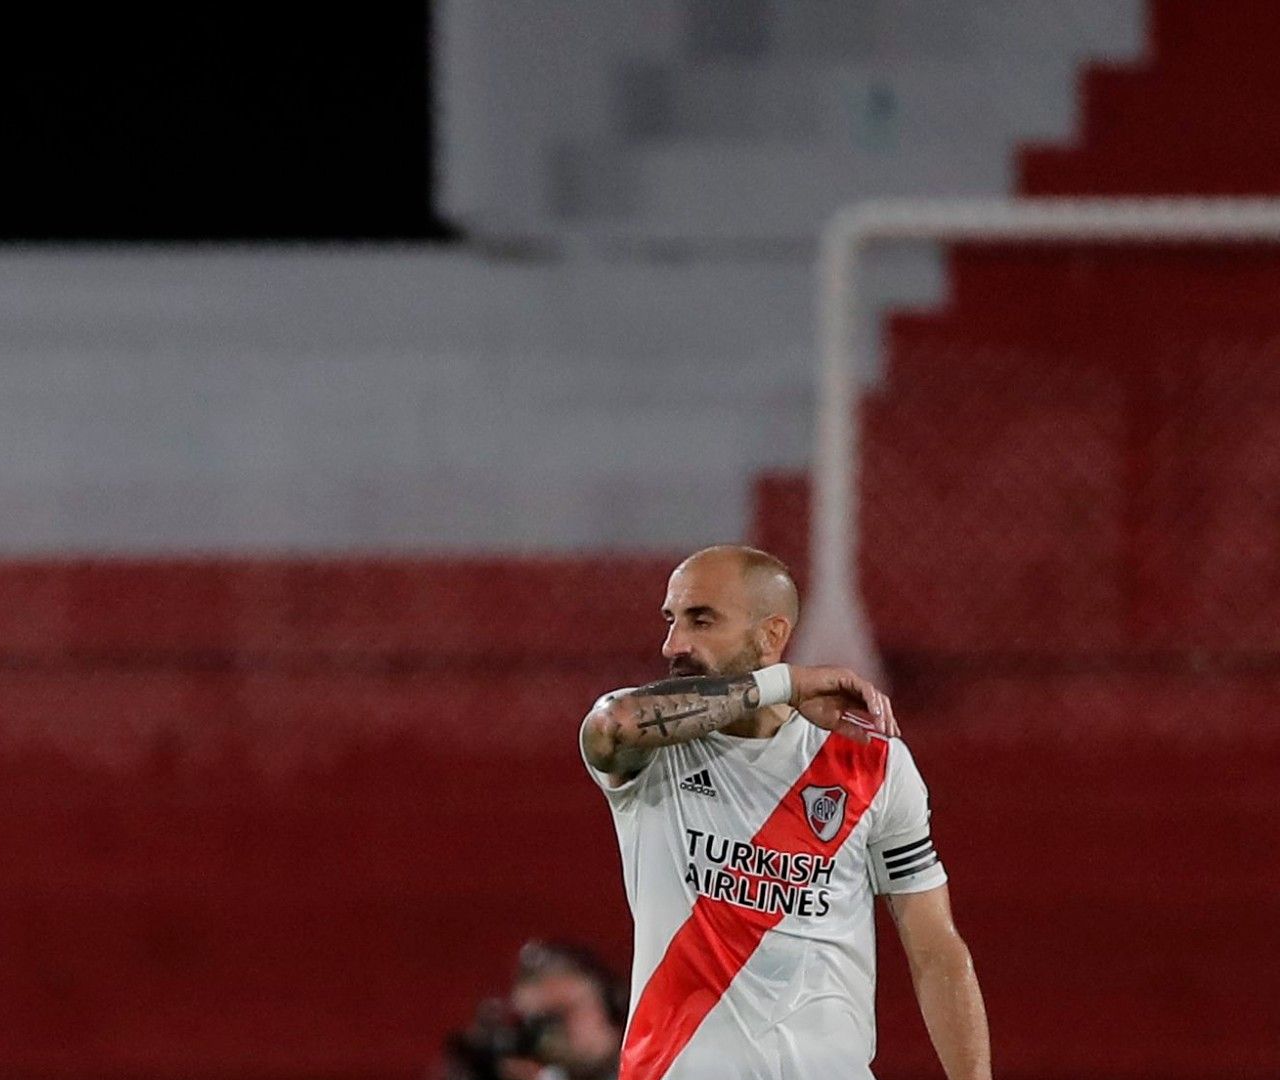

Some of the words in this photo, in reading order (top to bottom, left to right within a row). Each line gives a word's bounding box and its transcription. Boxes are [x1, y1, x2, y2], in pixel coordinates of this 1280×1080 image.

[680, 781, 716, 797] adidas
[686, 828, 836, 885] TURKISH
[684, 862, 830, 917] AIRLINES
